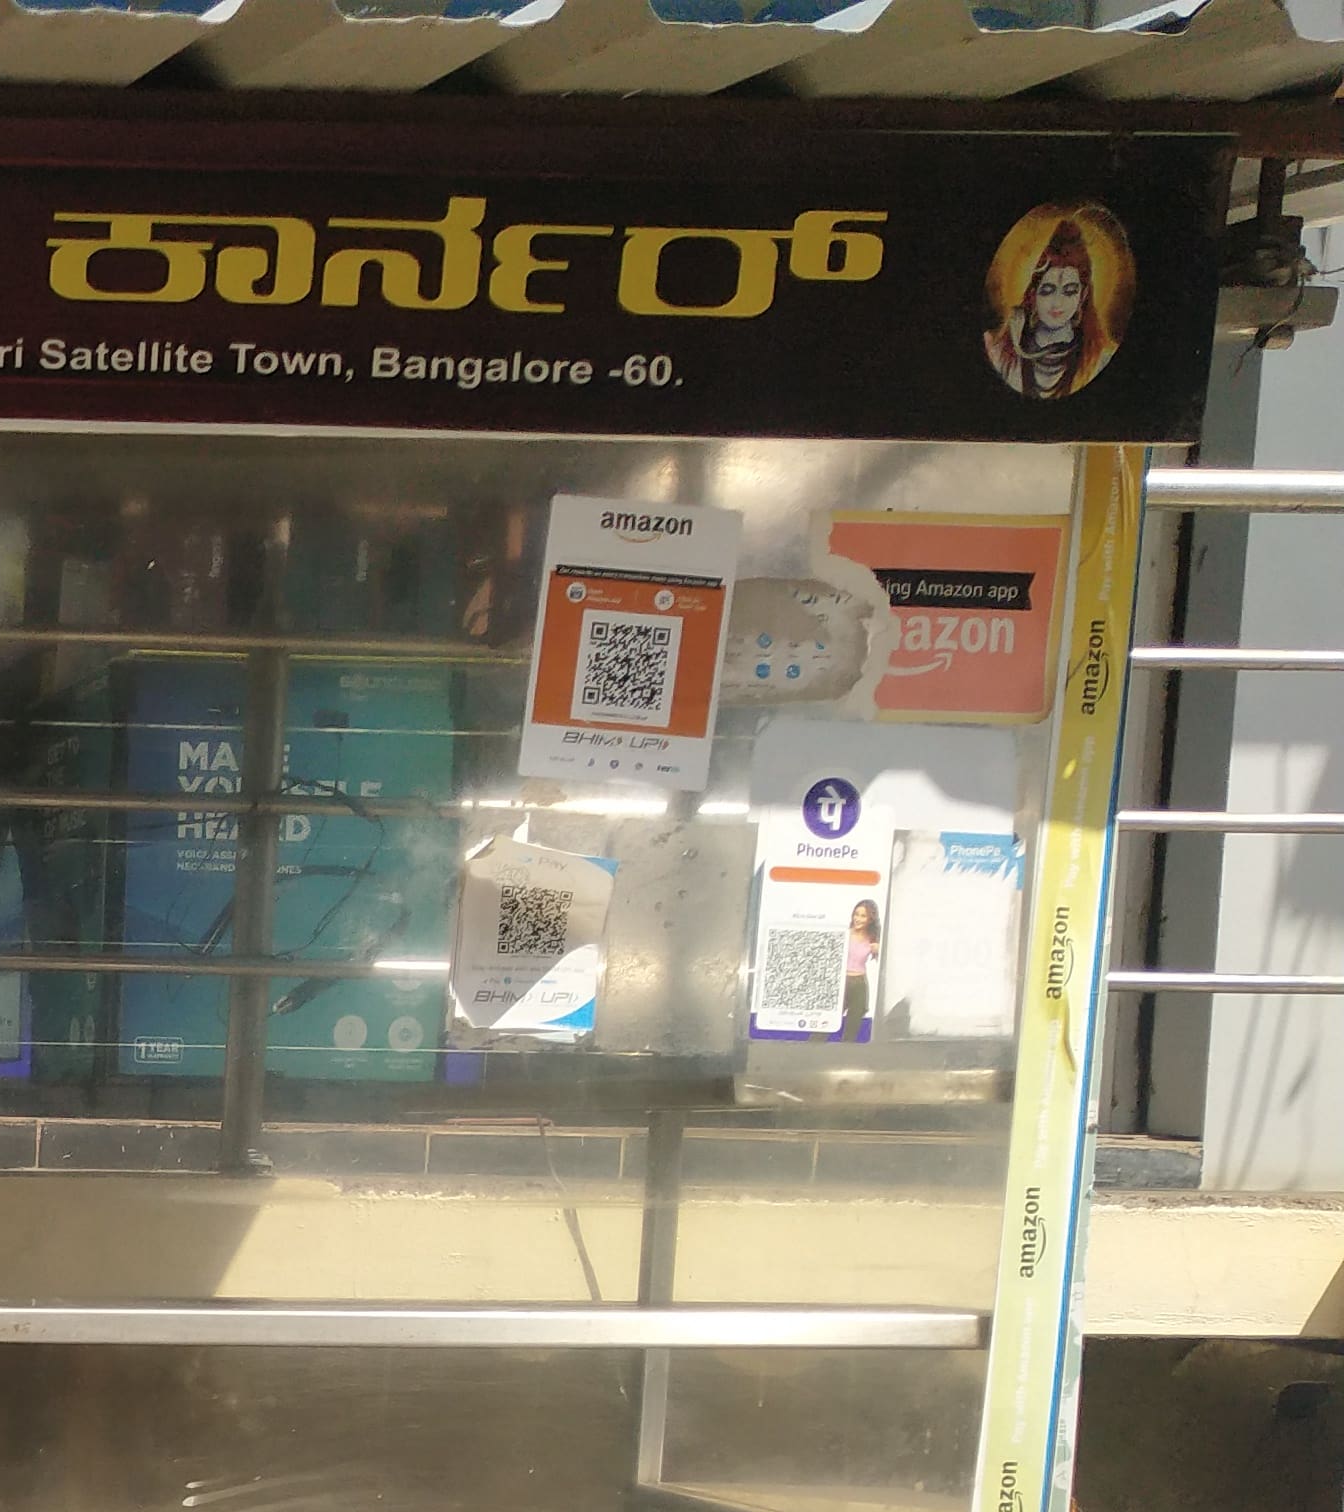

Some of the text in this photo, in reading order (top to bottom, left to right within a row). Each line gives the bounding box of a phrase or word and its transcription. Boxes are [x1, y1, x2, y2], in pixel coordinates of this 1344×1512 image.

[47, 197, 887, 317] ಕಾರ್ನರ್
[40, 339, 212, 373] Satellite
[229, 344, 353, 382] Town,
[372, 348, 592, 389] Bangalore
[609, 355, 682, 385] -60.
[600, 510, 693, 536] amazon
[916, 580, 982, 597] Amazon
[987, 584, 1019, 601] app
[1081, 619, 1106, 715] amazon
[797, 842, 859, 859] PhonePe
[1046, 907, 1070, 1001] amazon
[1020, 1186, 1041, 1279] amazon
